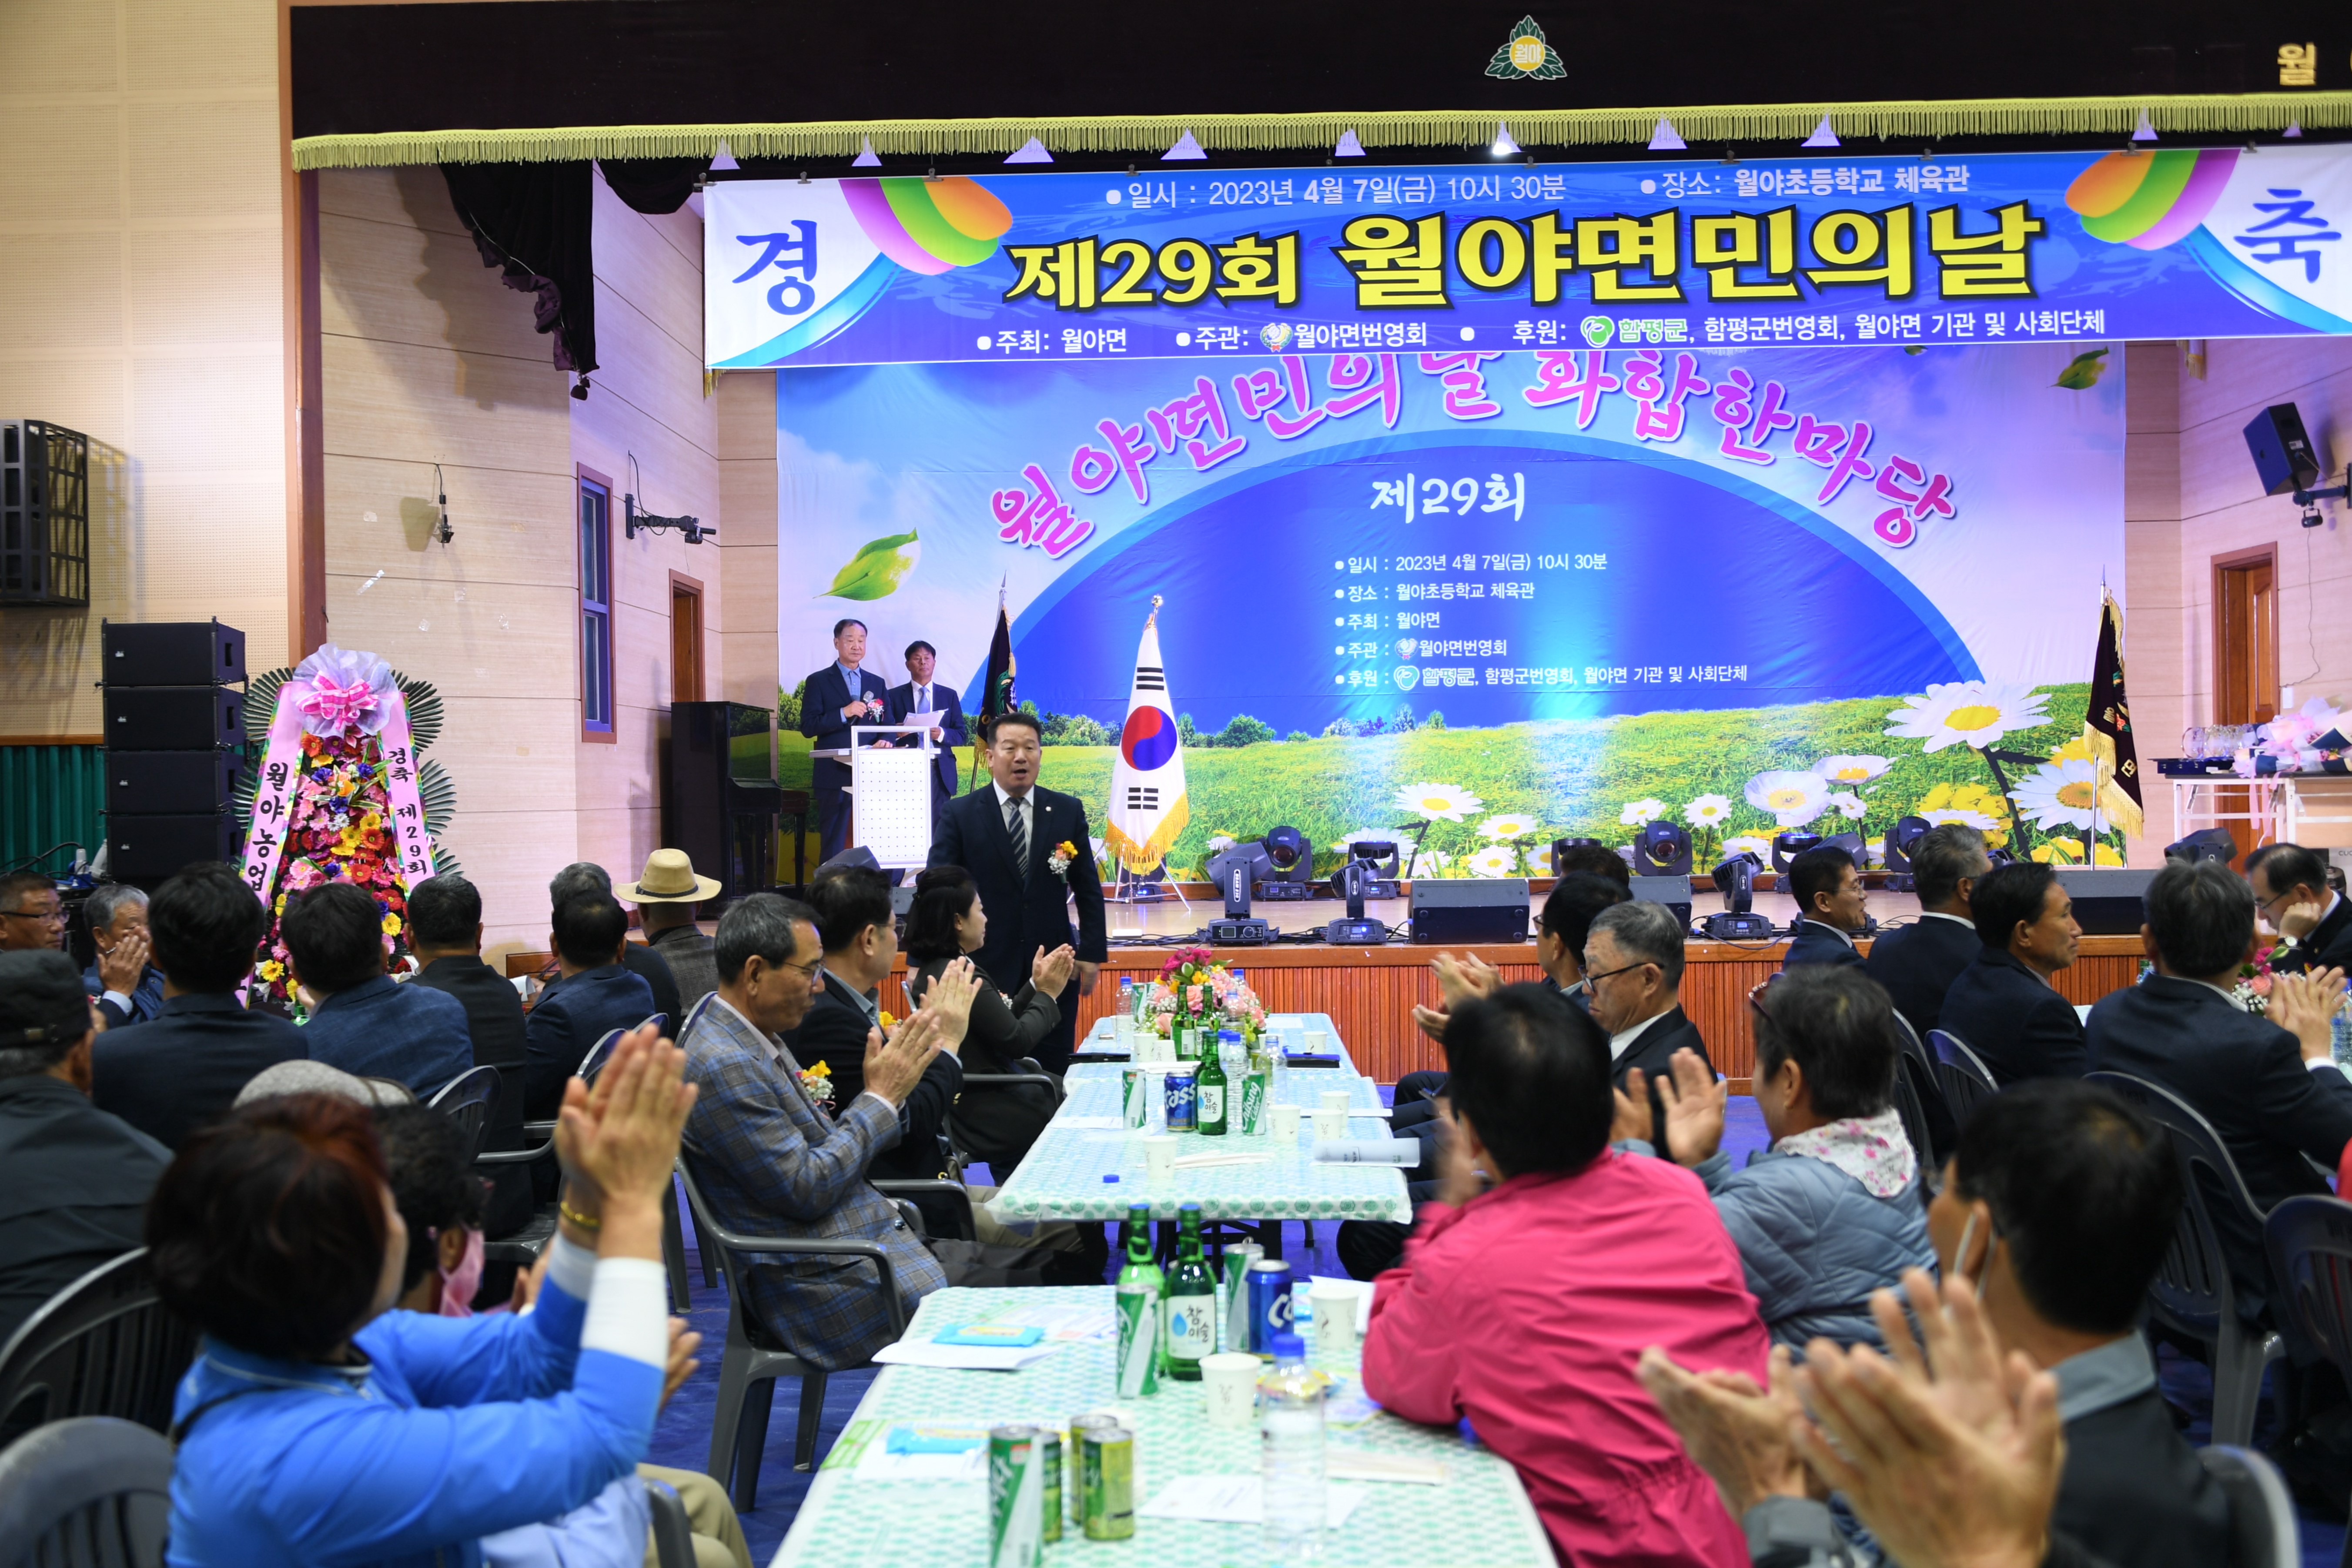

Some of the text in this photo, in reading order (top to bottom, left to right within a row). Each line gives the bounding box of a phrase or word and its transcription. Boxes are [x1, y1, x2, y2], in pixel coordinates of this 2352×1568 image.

[1515, 44, 1541, 63] 월야
[2277, 42, 2316, 85] 월
[1128, 181, 1176, 209] 일시
[1209, 179, 1293, 205] 2023년
[1304, 177, 1343, 204] 4월
[1353, 175, 1435, 204] 7일(금)
[1448, 175, 1500, 201] 10시
[1511, 174, 1566, 200] 30분
[1662, 165, 1970, 199] 장소: 월야초등학교 체육관
[2233, 188, 2342, 284] 축
[732, 219, 817, 315] 경
[1002, 198, 2044, 312] 제29회 월야면민의날
[996, 328, 1127, 354] 주최: 월야면
[1195, 322, 1426, 351] 주관: 월야면번영회
[1512, 320, 1566, 345] 후원:
[1704, 315, 1845, 342] 함평군번영회,
[1855, 314, 1921, 339] 월야면
[1931, 312, 1976, 338] 기관
[1985, 311, 2005, 336] 및
[2014, 309, 2104, 335] 사회단체
[1370, 472, 1525, 524] 제29회
[1348, 556, 1377, 573] 일시
[1396, 554, 1446, 571] 2023년
[1452, 554, 1476, 571] 4월
[1482, 553, 1531, 571] 7일(금)
[1537, 553, 1569, 570] 10시
[1575, 553, 1607, 570] 30분
[1348, 585, 1378, 602] 장소
[1396, 582, 1485, 601] 월야초등학교
[1490, 582, 1535, 599] 체육관
[1348, 613, 1377, 630] 주최
[1396, 612, 1440, 629] 월야면
[1348, 642, 1378, 659] 주관
[1419, 639, 1506, 657] 월야면번영회
[1348, 670, 1377, 687] 후원
[1485, 667, 1578, 685] 함평군번영회,
[1584, 667, 1627, 684] 월야면
[1634, 666, 1663, 683] 기관
[1669, 666, 1682, 682] 및
[1688, 665, 1747, 682] 사회단체
[388, 747, 427, 875] 경축 제29회
